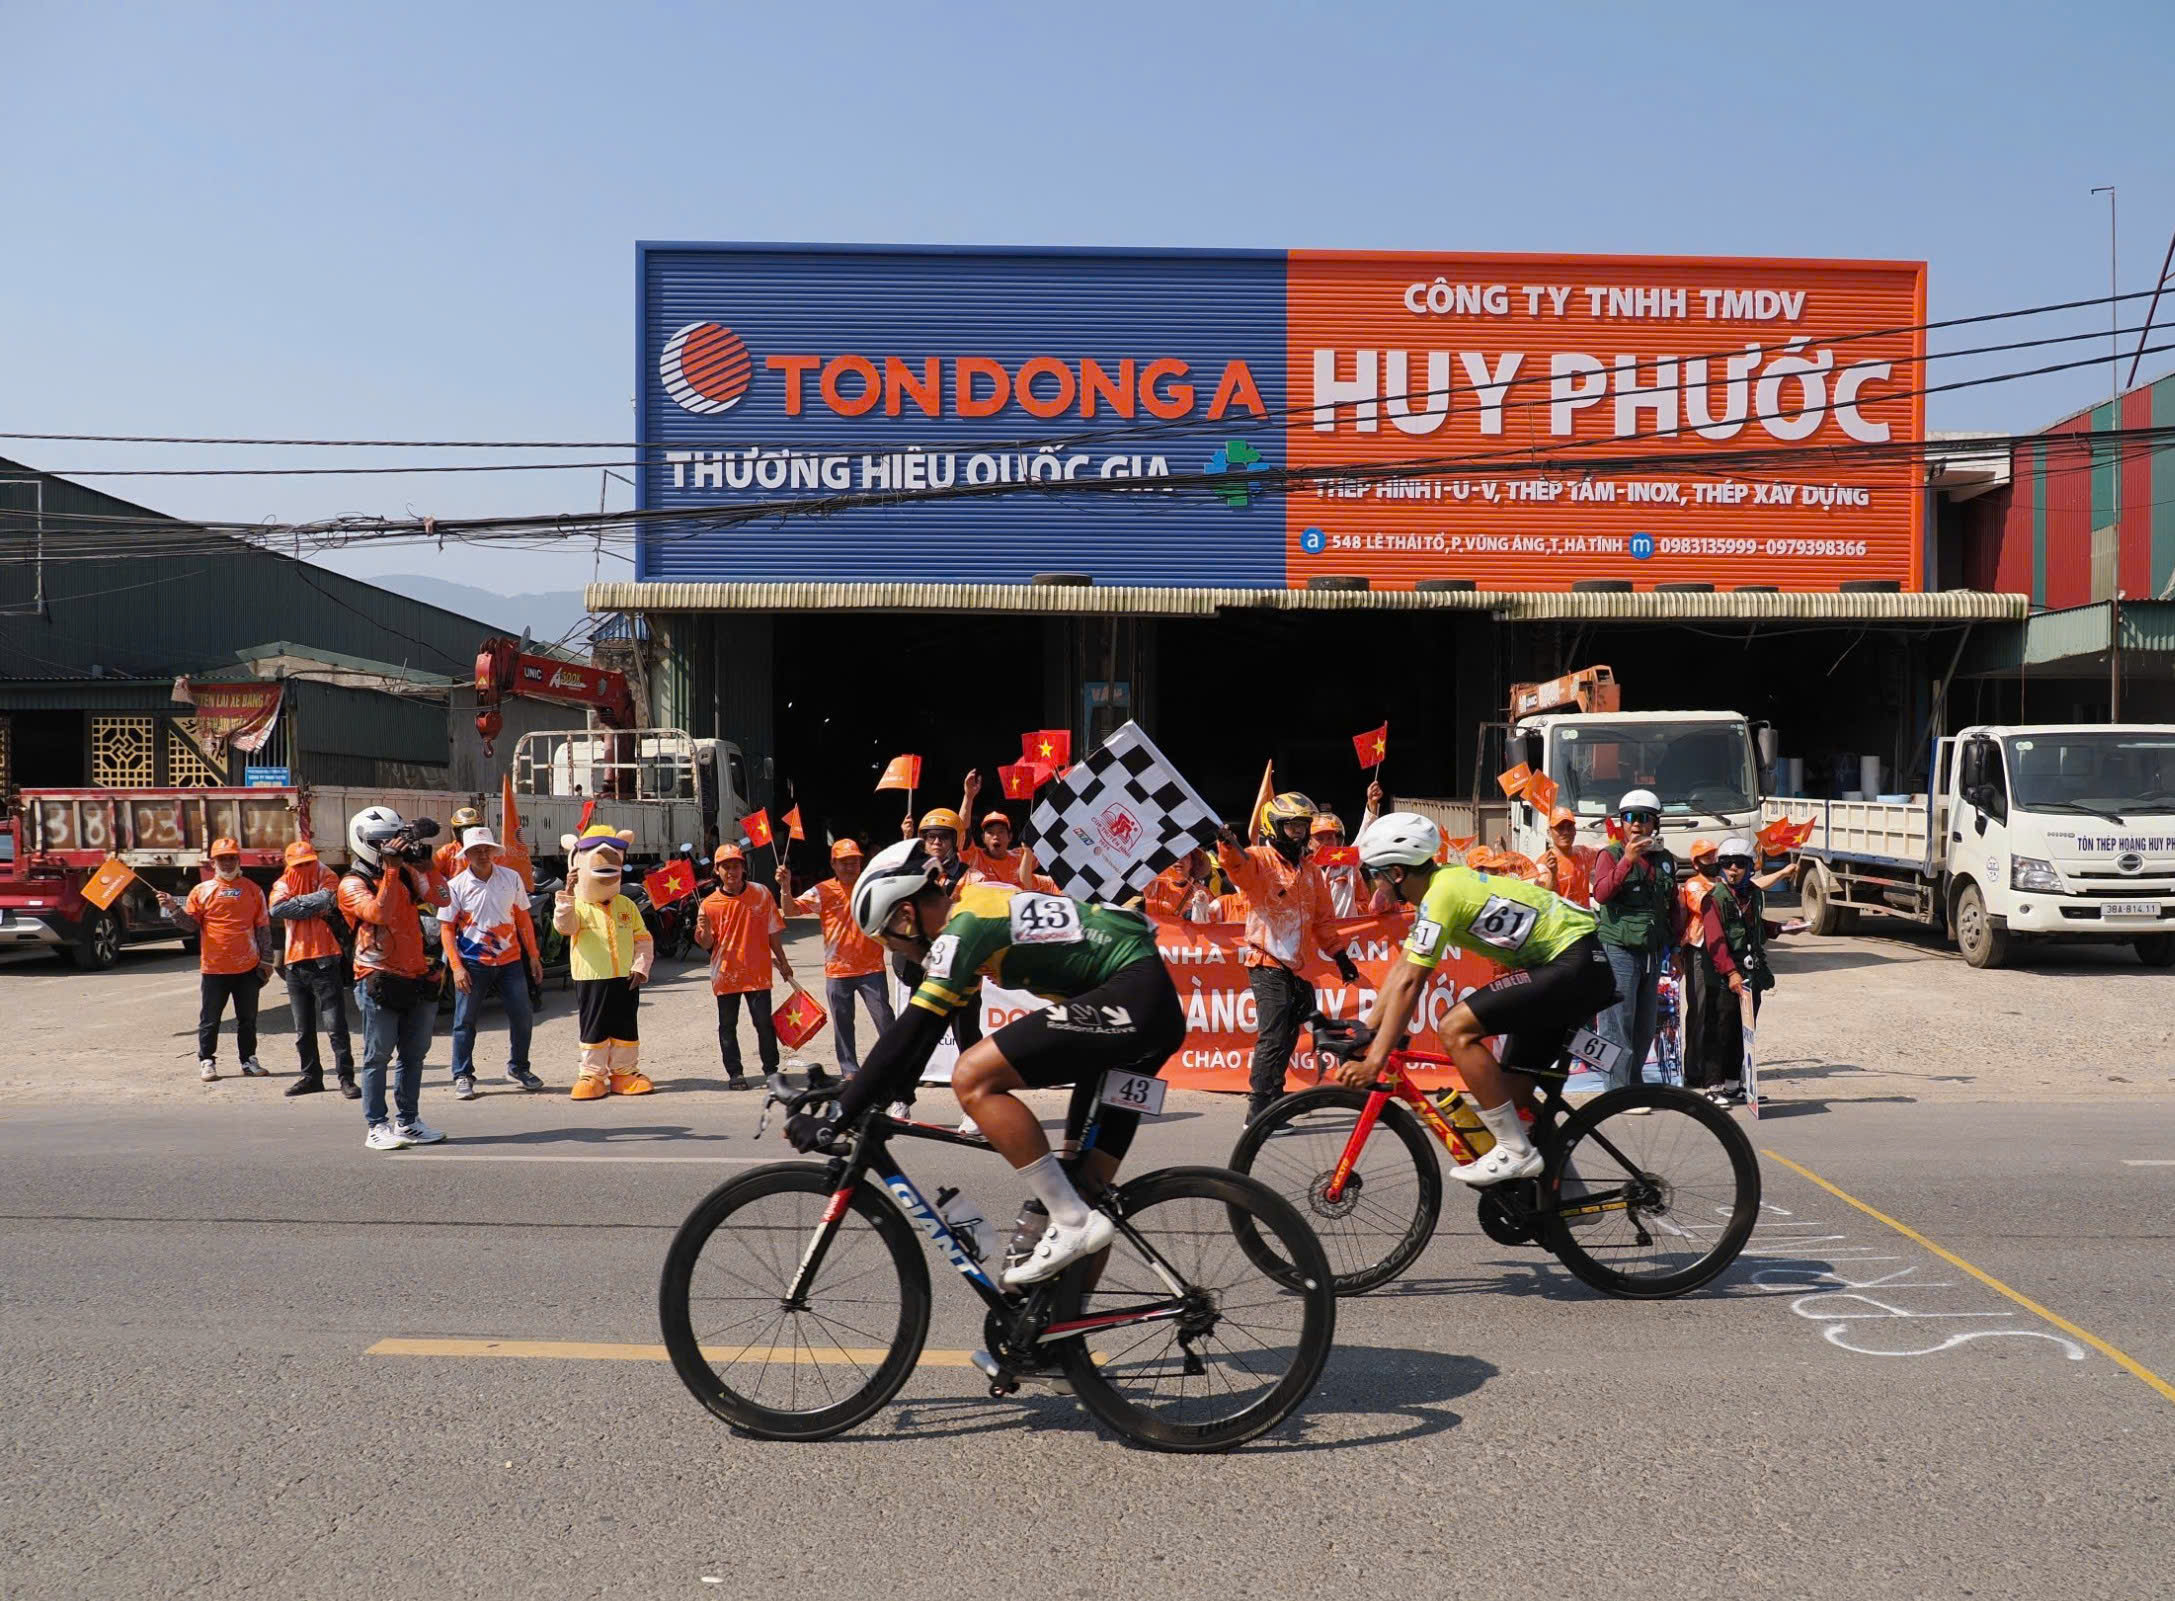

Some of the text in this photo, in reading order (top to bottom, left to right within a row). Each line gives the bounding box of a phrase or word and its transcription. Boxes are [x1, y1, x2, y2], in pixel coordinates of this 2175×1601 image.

[1404, 276, 1807, 320] CÔNG TY TNHH TMDV
[1313, 336, 1892, 442] HUY PHƯỚC
[666, 446, 850, 490] THƯƠNG
[1100, 455, 1174, 491] GIA
[1506, 477, 1563, 501] THÉP
[1692, 479, 1749, 503] THÉP
[1753, 480, 1796, 504] XÂY
[1802, 482, 1870, 511] DỰNG
[1332, 535, 1361, 549] 548
[1366, 532, 1385, 549] LÊ
[1386, 533, 1422, 549] THÁI
[524, 666, 542, 680] UNIC
[2078, 835, 2094, 851] TÔN
[2118, 834, 2147, 852] HOÀNG
[2148, 837, 2164, 851] HUY
[1020, 898, 1071, 930] 43
[1484, 906, 1525, 942] 61
[1178, 975, 1259, 1033] ÀNG
[1182, 1046, 1241, 1070] CHÀO
[1584, 1038, 1608, 1062] 61
[1120, 1078, 1150, 1104] 43
[889, 1182, 981, 1276] GIANT
